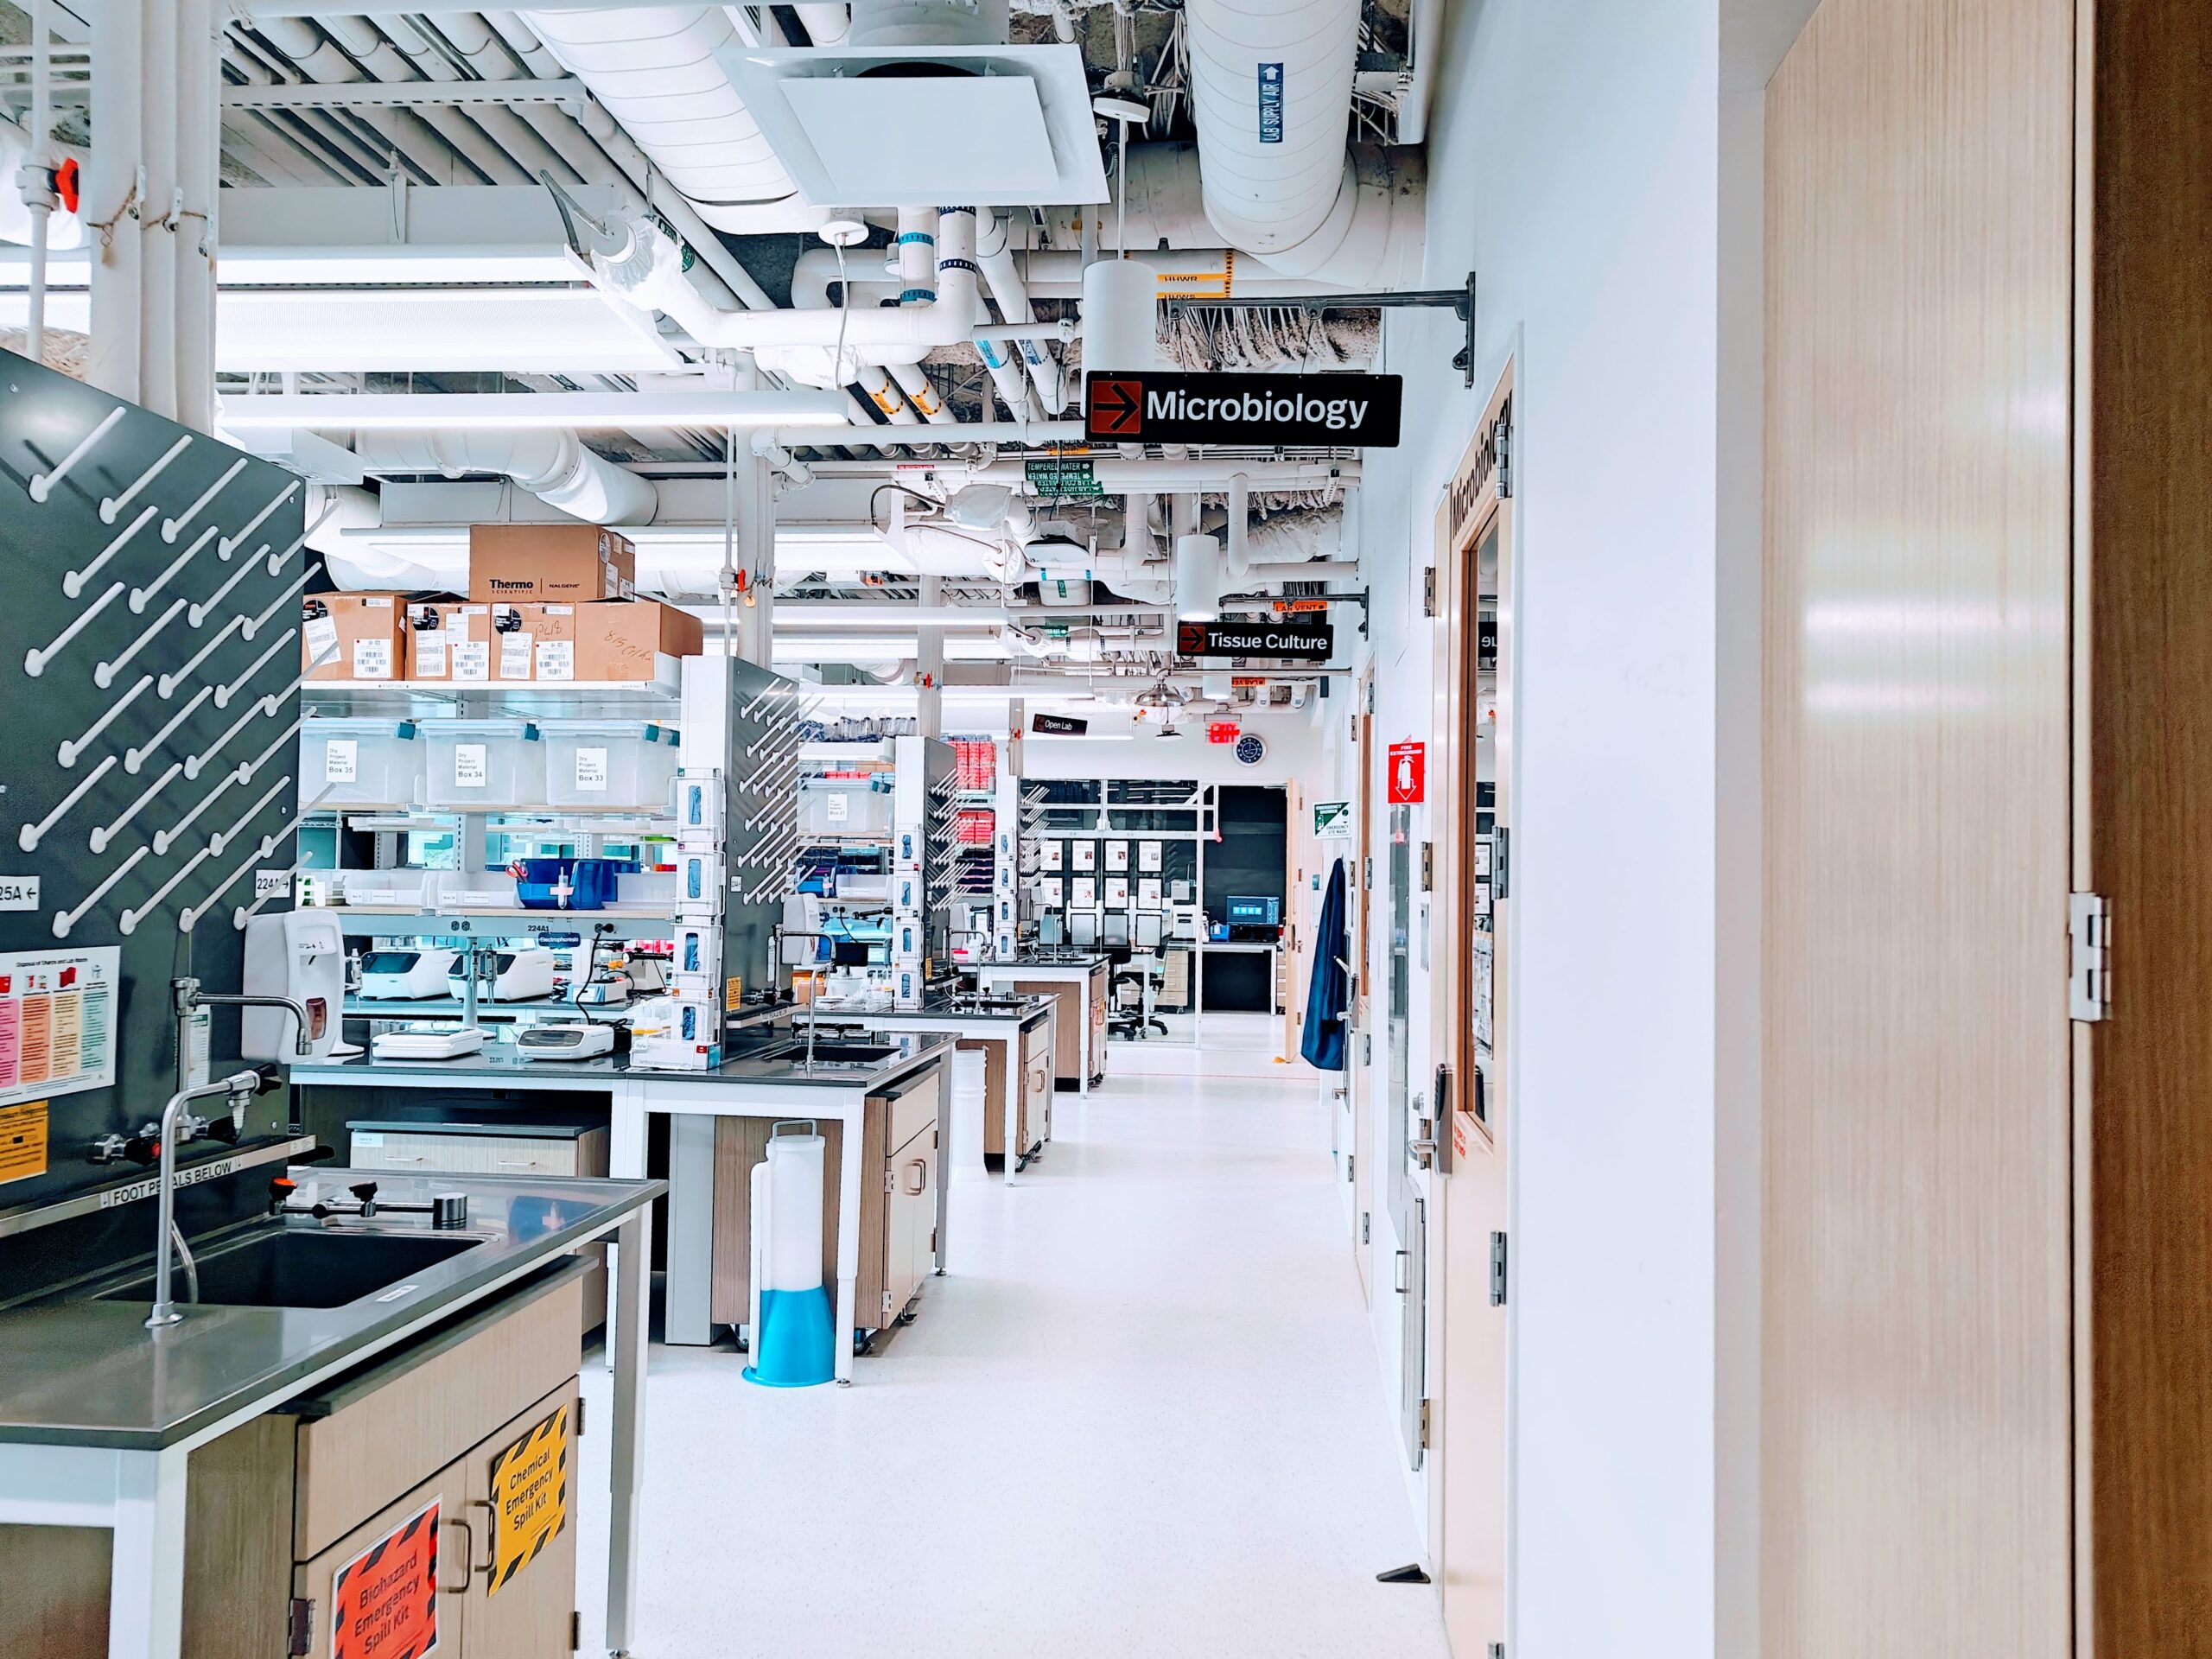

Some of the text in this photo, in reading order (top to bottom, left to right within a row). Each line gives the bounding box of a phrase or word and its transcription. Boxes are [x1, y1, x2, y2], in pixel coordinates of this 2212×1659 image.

[1262, 83, 1280, 141] LAB SUPPLY AIR
[1147, 389, 1369, 429] Microbiology
[1027, 462, 1081, 471] TEMPERED WATER
[1027, 472, 1082, 480] TEMPEED WATER
[489, 579, 533, 589] Thermo
[1208, 632, 1328, 650] Tissue Culture
[1045, 719, 1072, 731] Open Lab
[257, 878, 280, 890] 224
[113, 1160, 232, 1205] FOOT PEALS BELOW
[510, 1446, 550, 1491] Chemical
[505, 1467, 553, 1516] Emergency
[513, 1505, 534, 1531] Spill
[535, 1492, 547, 1511] Kit
[359, 1548, 417, 1610] Biohazard
[354, 1574, 420, 1637] Emergency
[364, 1619, 391, 1655] Spill
[393, 1604, 410, 1630] Kit
